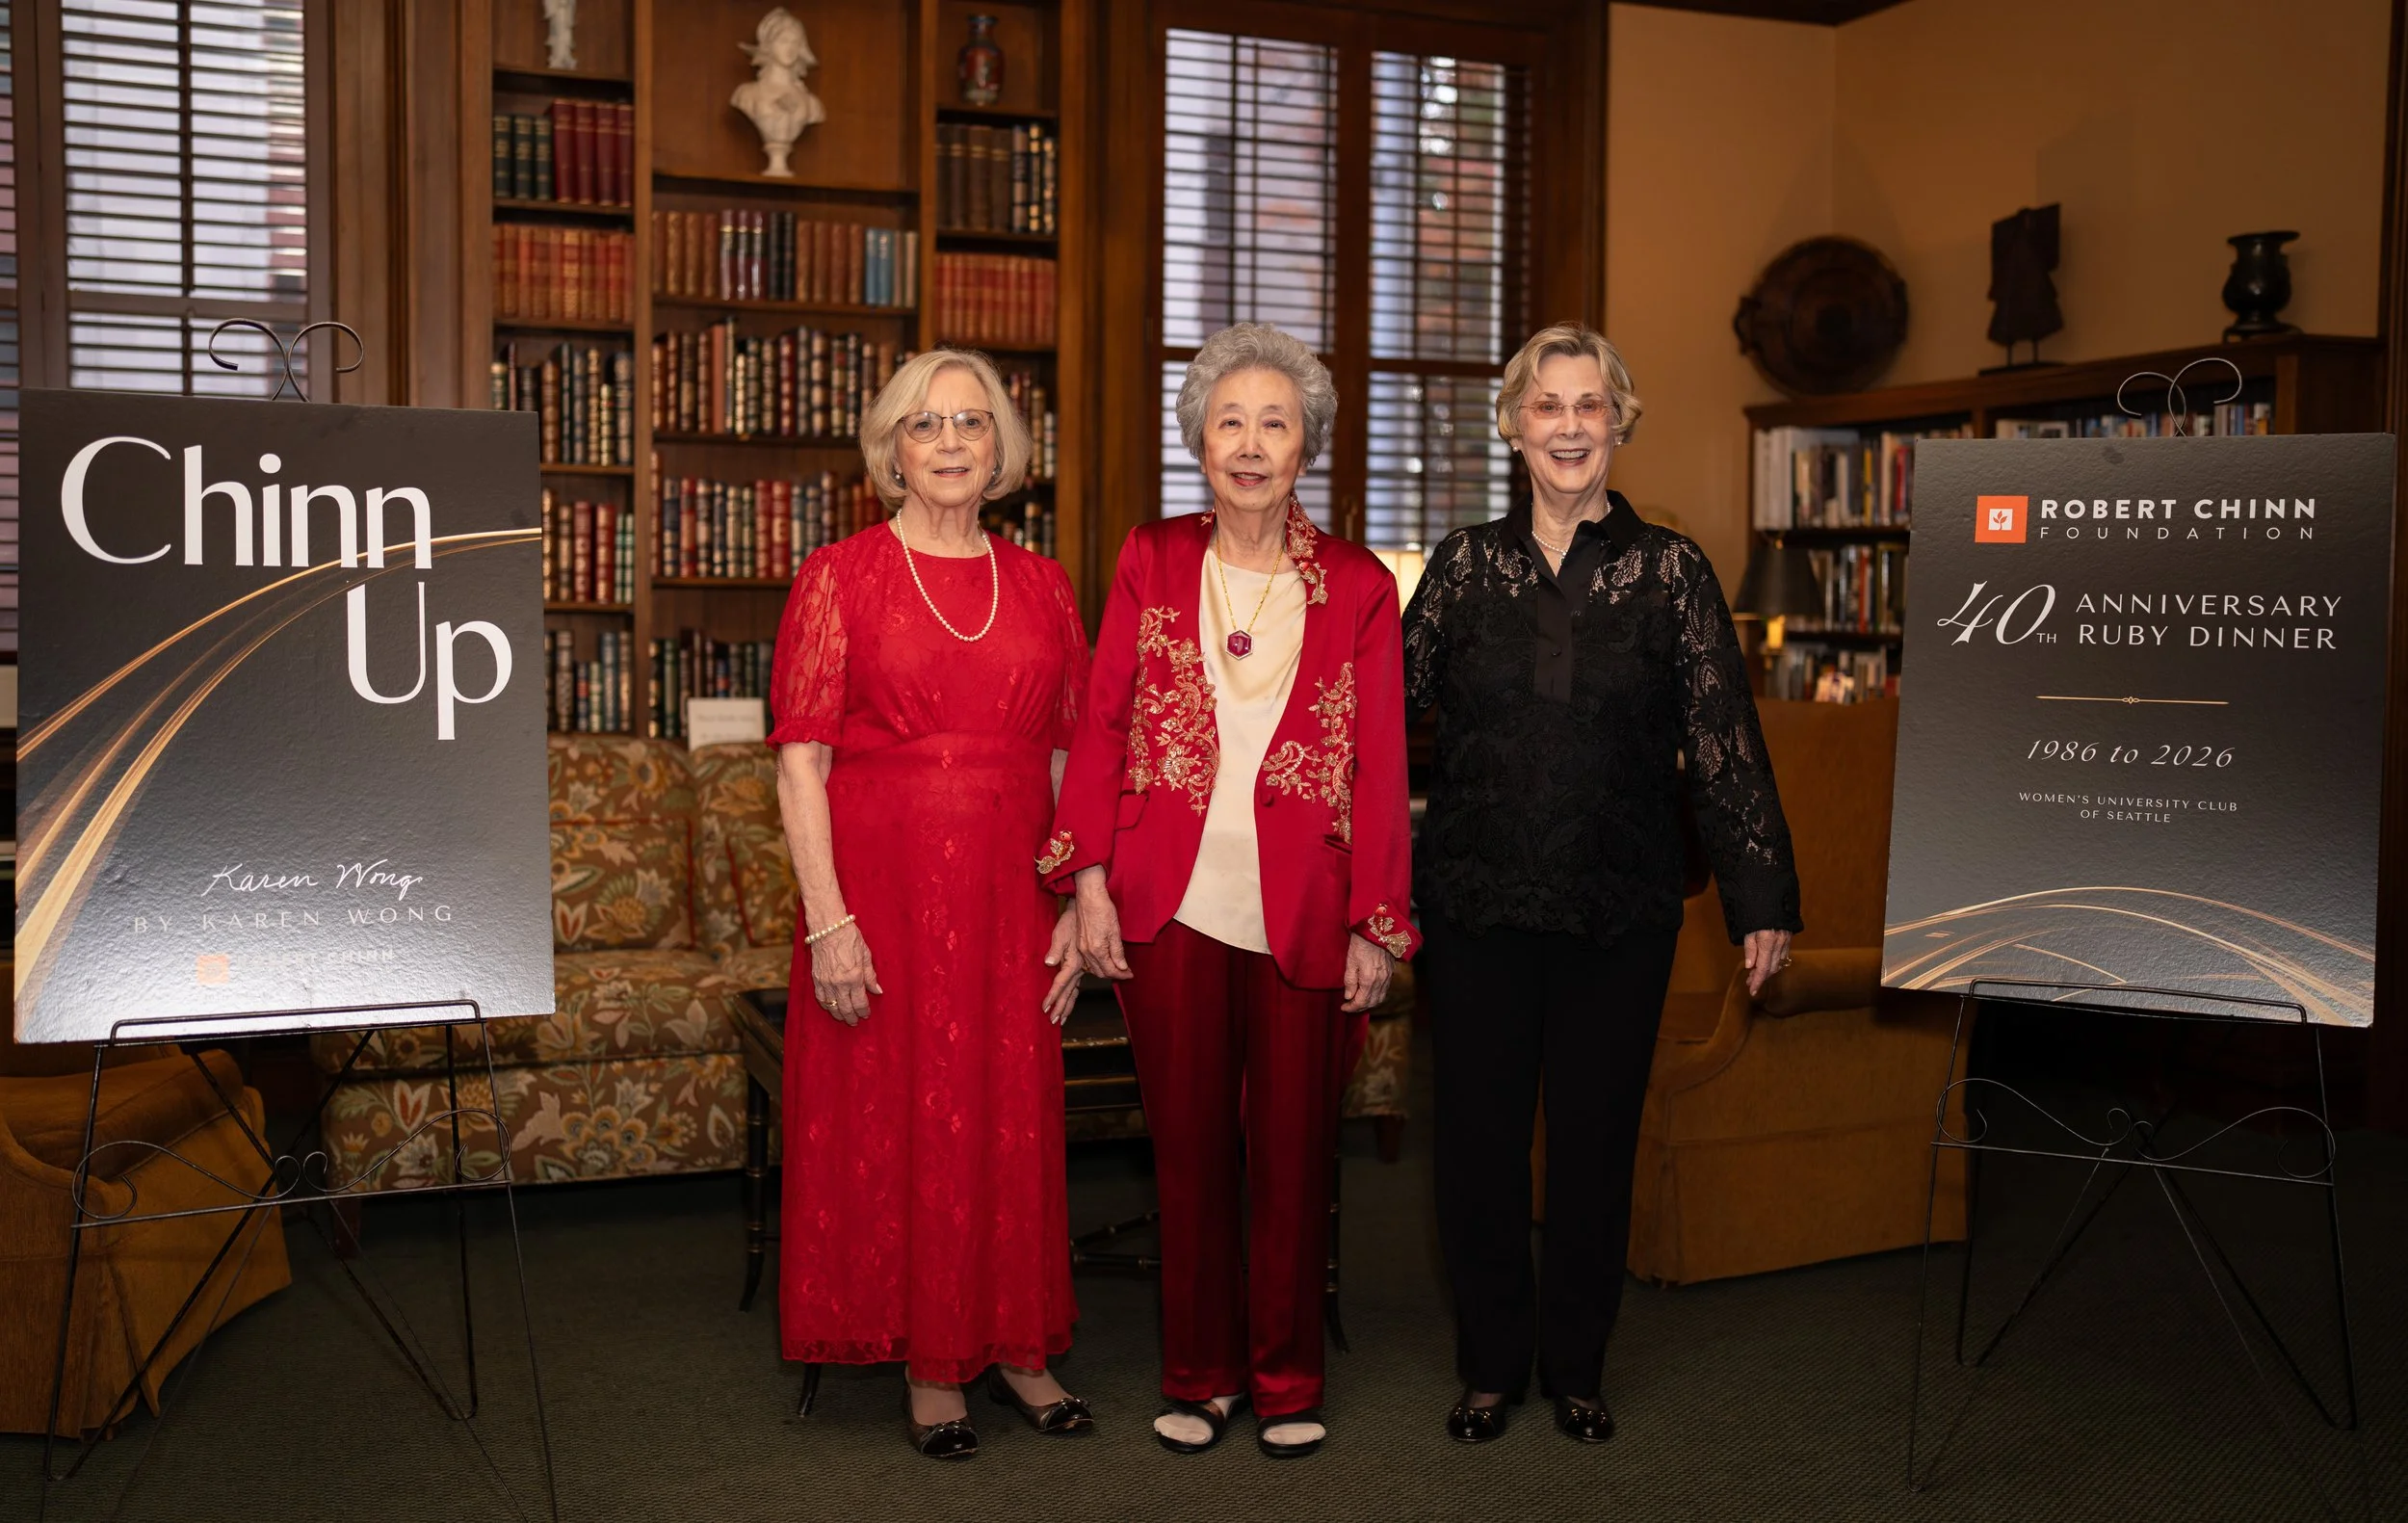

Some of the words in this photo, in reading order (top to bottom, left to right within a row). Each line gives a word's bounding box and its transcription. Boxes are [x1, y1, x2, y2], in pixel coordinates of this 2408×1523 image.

[60, 435, 432, 569] Chinn
[2040, 498, 2178, 520] ROBERT
[2193, 497, 2316, 519] CHINN
[2040, 526, 2314, 540] FOUNDATION
[2076, 592, 2343, 617] ANNIVERSARY
[2079, 624, 2169, 646] RUBY
[2189, 625, 2338, 650] DINNER
[346, 580, 513, 741] Up
[2028, 739, 2100, 762] 1986
[2109, 745, 2139, 764] to
[2150, 745, 2236, 768] 2026
[2019, 792, 2090, 805] WOMEN'S
[2097, 796, 2191, 810] UNIVERSITY
[2197, 801, 2238, 812] CLUB
[2080, 809, 2100, 820] OF
[2107, 810, 2171, 824] SEATTLE
[200, 862, 319, 898] Karen
[335, 858, 424, 902] Wong
[134, 916, 173, 934] BY
[202, 911, 320, 931] KAREN
[348, 905, 451, 925] WONG
